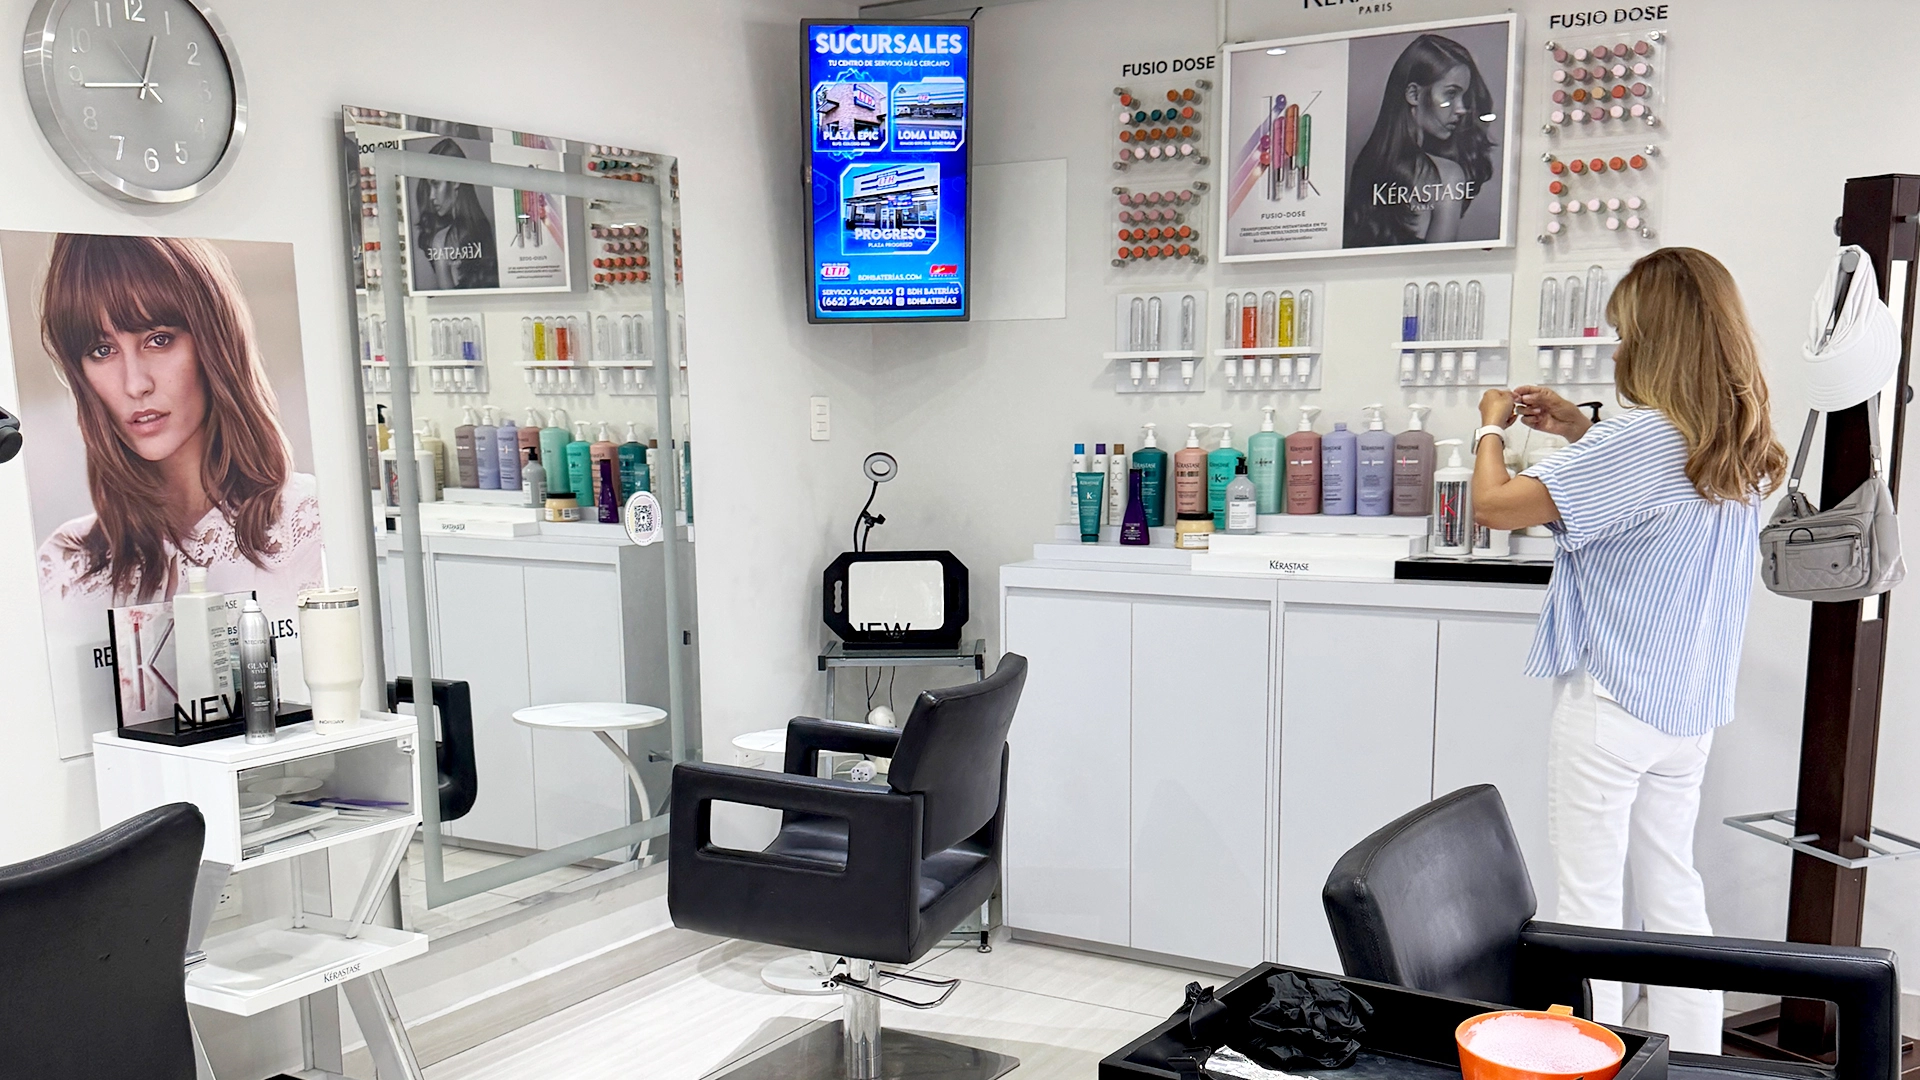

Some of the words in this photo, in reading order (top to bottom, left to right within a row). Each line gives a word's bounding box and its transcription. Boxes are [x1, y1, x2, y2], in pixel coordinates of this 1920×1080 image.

[94, 1, 112, 28] 11
[124, 0, 146, 22] 12
[1358, 3, 1393, 15] PARIS
[1550, 11, 1608, 29] FUSIO
[1614, 4, 1669, 24] DOSE
[164, 11, 170, 35] 1
[70, 28, 91, 53] 10
[816, 33, 963, 55] SUCURSALES
[187, 42, 200, 66] 2
[1122, 61, 1168, 77] FUSIO
[1172, 55, 1216, 72] DOSE
[83, 106, 98, 130] 8
[823, 131, 856, 141] PLAZA
[857, 131, 879, 141] EPIC
[898, 131, 927, 141] LOMA
[928, 131, 958, 140] LINDA
[109, 135, 125, 161] 7
[175, 141, 189, 165] 5
[144, 148, 160, 172] 6
[1372, 181, 1476, 206] KÉRASTASE
[1260, 210, 1306, 220] FUSIO-DOSE
[854, 228, 926, 241] PROGRESO
[825, 267, 847, 276] LTH
[822, 297, 847, 307] (662)
[849, 296, 893, 306] 214-0241
[1269, 560, 1309, 571] KÉRASTASE
[247, 662, 269, 670] GLAM
[323, 962, 361, 983] KÉRASTASE
